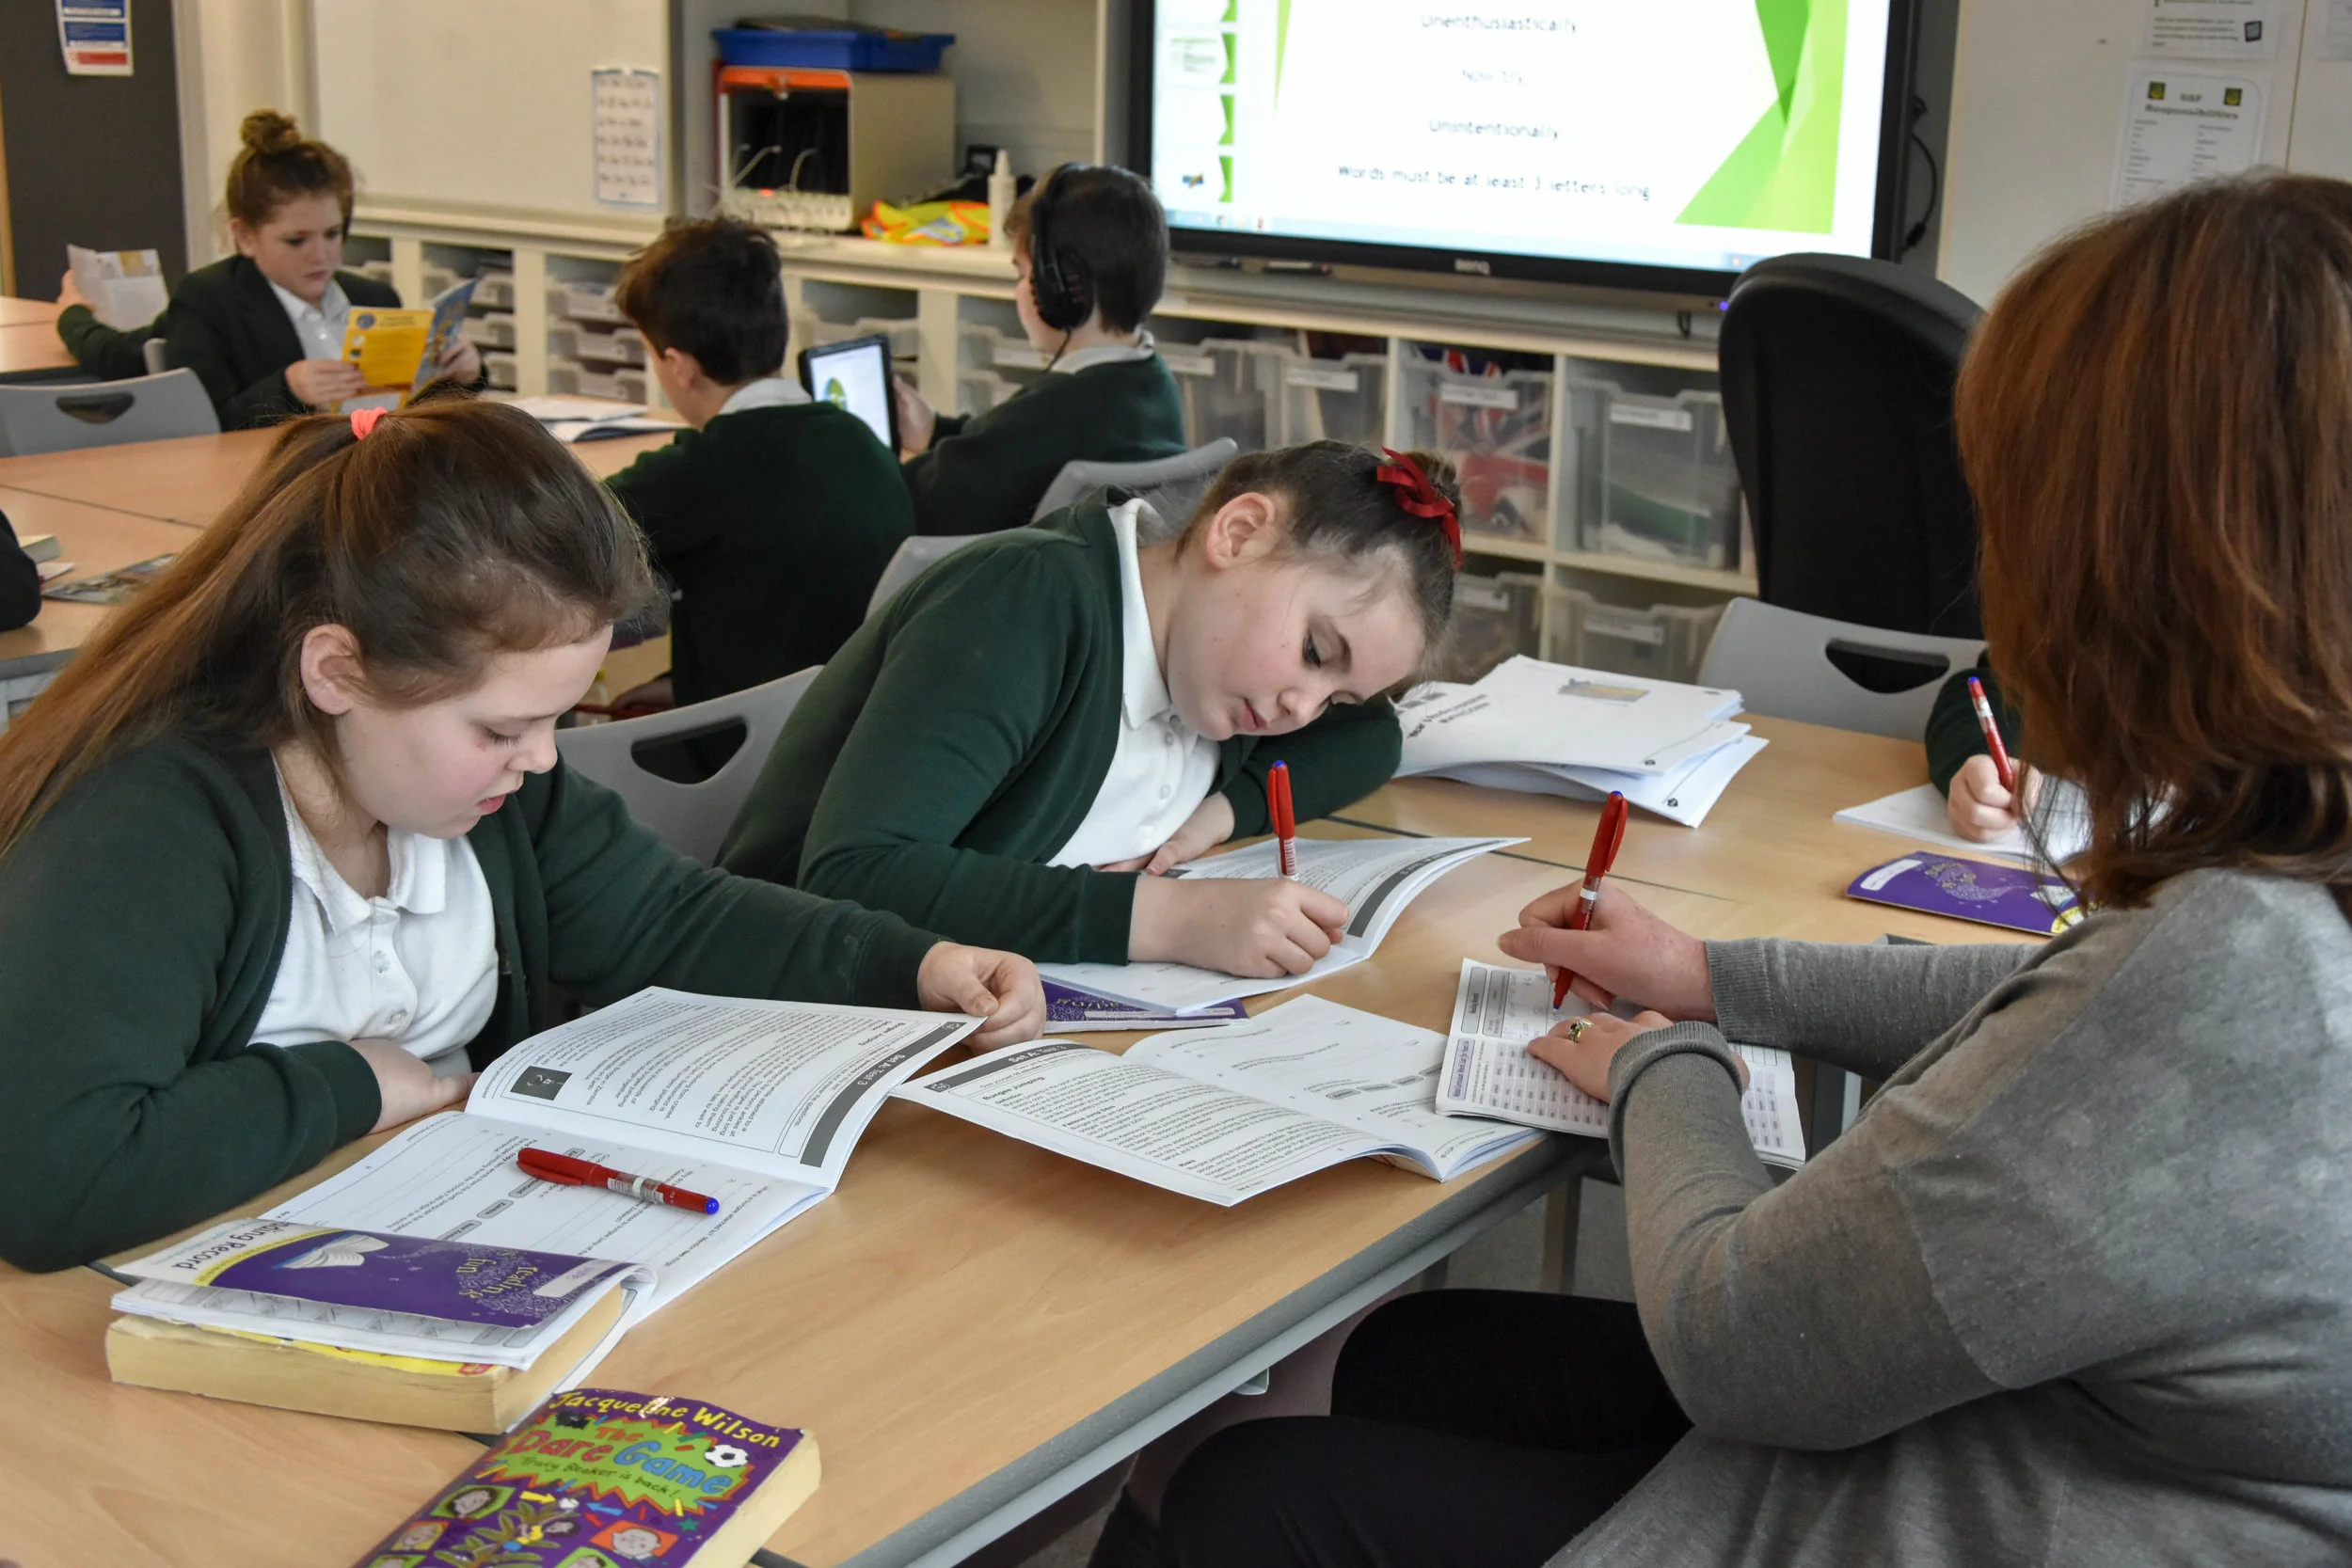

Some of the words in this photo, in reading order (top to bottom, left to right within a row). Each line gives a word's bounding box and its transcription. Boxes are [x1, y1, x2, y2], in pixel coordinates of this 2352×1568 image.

[1430, 118, 1558, 142] Unintentionally
[1338, 163, 1385, 182] Words
[1393, 168, 1430, 183] must
[1438, 169, 1455, 184] be
[1464, 172, 1478, 186] at
[1486, 173, 1524, 188] least
[866, 1066, 883, 1080] Test
[720, 1123, 730, 1135] long
[230, 1222, 296, 1246] ading
[171, 1238, 246, 1271] Record
[455, 1258, 497, 1274] fun
[459, 1266, 538, 1298] reading
[595, 1426, 644, 1443] The
[691, 1406, 781, 1448] Wilson
[508, 1429, 614, 1465] Dare
[613, 1440, 734, 1495] Game
[519, 1457, 560, 1473] Tracy
[564, 1462, 617, 1479] Beaker
[618, 1469, 630, 1481] is
[634, 1476, 683, 1497] back!
